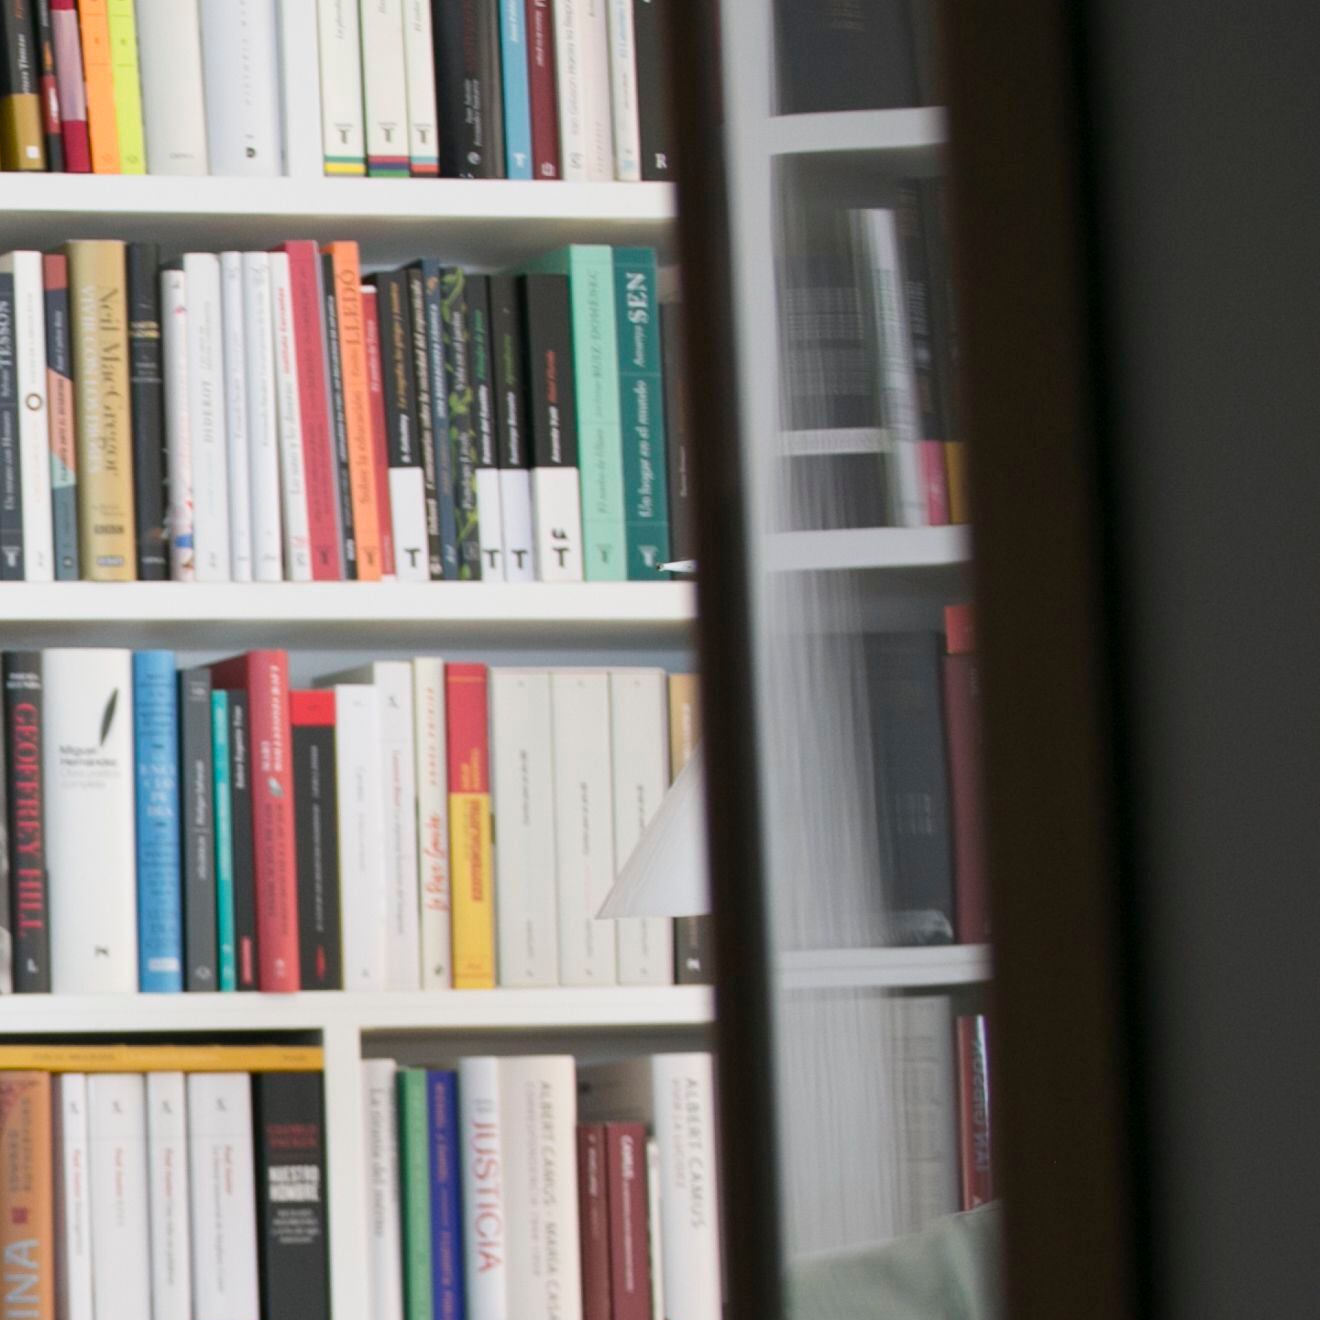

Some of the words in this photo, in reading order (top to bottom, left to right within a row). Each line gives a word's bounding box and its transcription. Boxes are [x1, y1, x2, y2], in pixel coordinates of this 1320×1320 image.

[80, 284, 97, 335] VIVIR
[96, 285, 120, 332] Neil
[336, 268, 361, 346] LLEDÓ
[625, 271, 650, 325] SEN
[82, 336, 99, 378] CON
[83, 378, 99, 413] LOS
[98, 340, 123, 478] MacGregor
[633, 380, 650, 425] mundo
[353, 389, 367, 453] educación
[357, 454, 368, 466] la
[638, 459, 655, 495] hogar
[358, 469, 371, 504] Sobre
[639, 496, 654, 518] Un
[59, 744, 97, 757] Miguel
[59, 756, 117, 768] Hernández
[14, 702, 42, 859] GEOFFREY
[423, 810, 446, 858] Gauche
[425, 865, 444, 893] Rive
[18, 867, 44, 939] HILL
[370, 1087, 386, 1104] La
[539, 1080, 556, 1141] ALBERT
[685, 1076, 704, 1149] ALBERT
[7, 1129, 20, 1194] EDWARD
[266, 1164, 321, 1182] NUESTRO
[542, 1144, 558, 1206] CAMUS
[621, 1133, 635, 1180] CAMUS
[268, 1184, 320, 1203] NOMBRE
[471, 1119, 503, 1274] JUSTICIA
[687, 1156, 707, 1231] CAMUS
[544, 1220, 563, 1275] MARÍA
